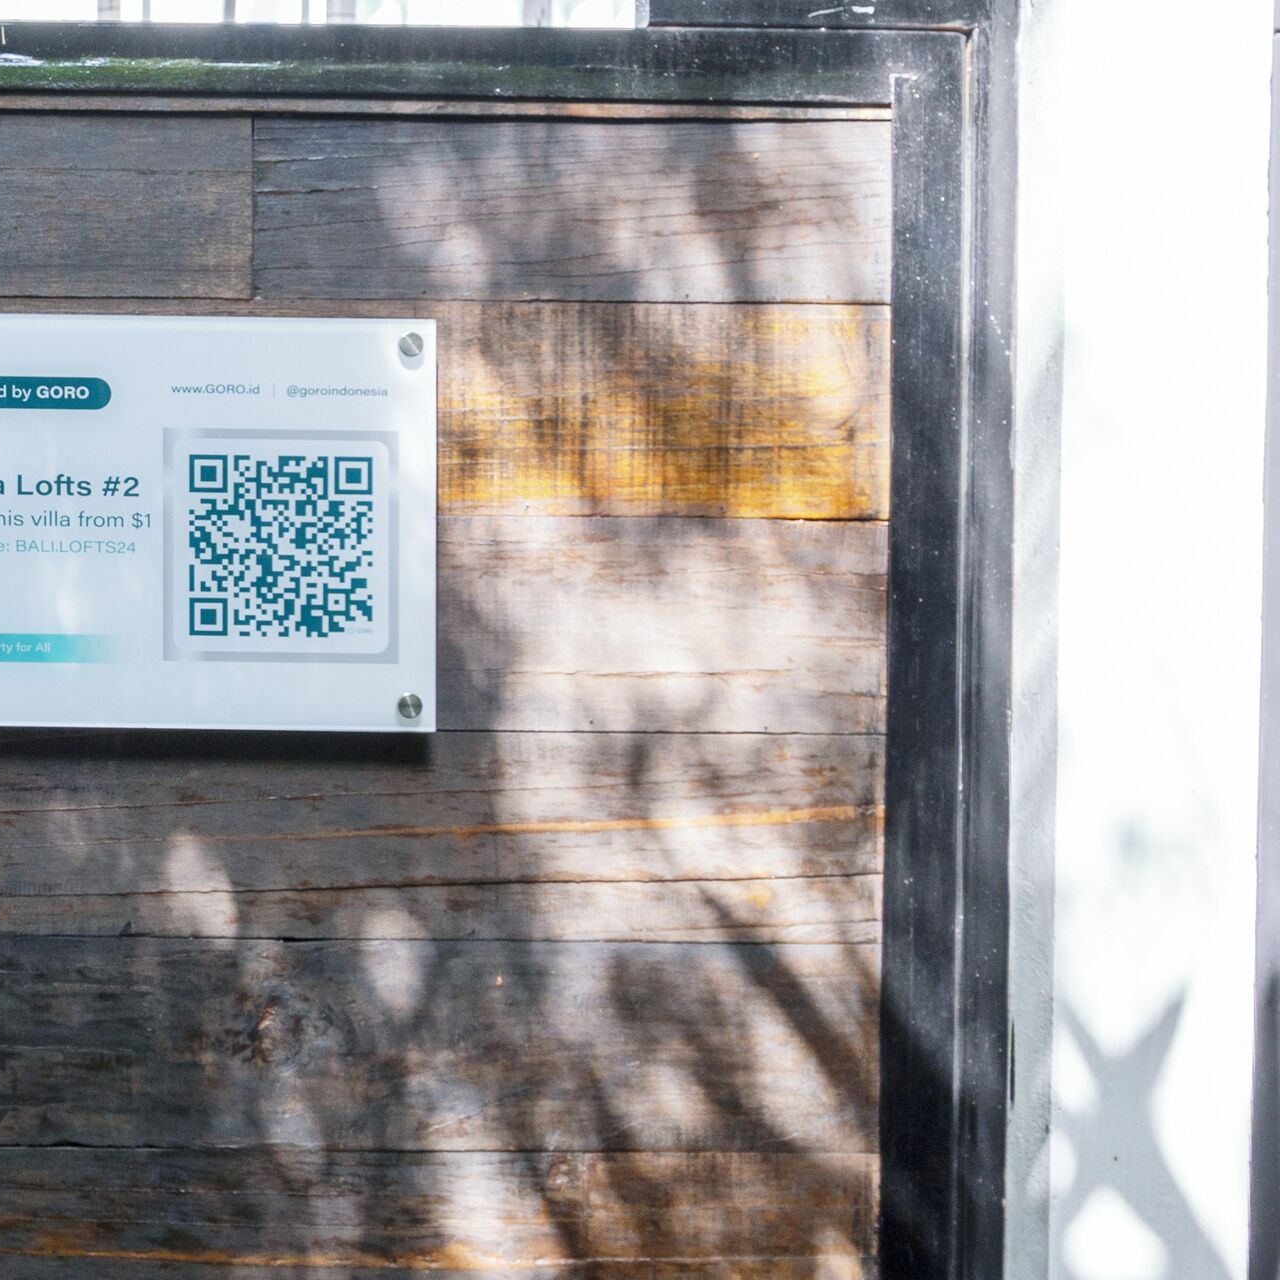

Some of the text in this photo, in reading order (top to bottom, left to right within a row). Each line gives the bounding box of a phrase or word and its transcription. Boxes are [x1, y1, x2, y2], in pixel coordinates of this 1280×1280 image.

[12, 385, 32, 402] by
[36, 385, 90, 399] GORO
[171, 384, 261, 395] www.GORO.id
[286, 385, 388, 398] @goroindonesia
[17, 473, 92, 496] Lofts
[102, 475, 140, 497] #2
[31, 510, 71, 528] villa
[78, 511, 124, 528] from
[131, 512, 152, 530] $1
[16, 539, 136, 554] BALI.LOFTS24
[16, 642, 32, 653] for
[35, 642, 51, 653] All
